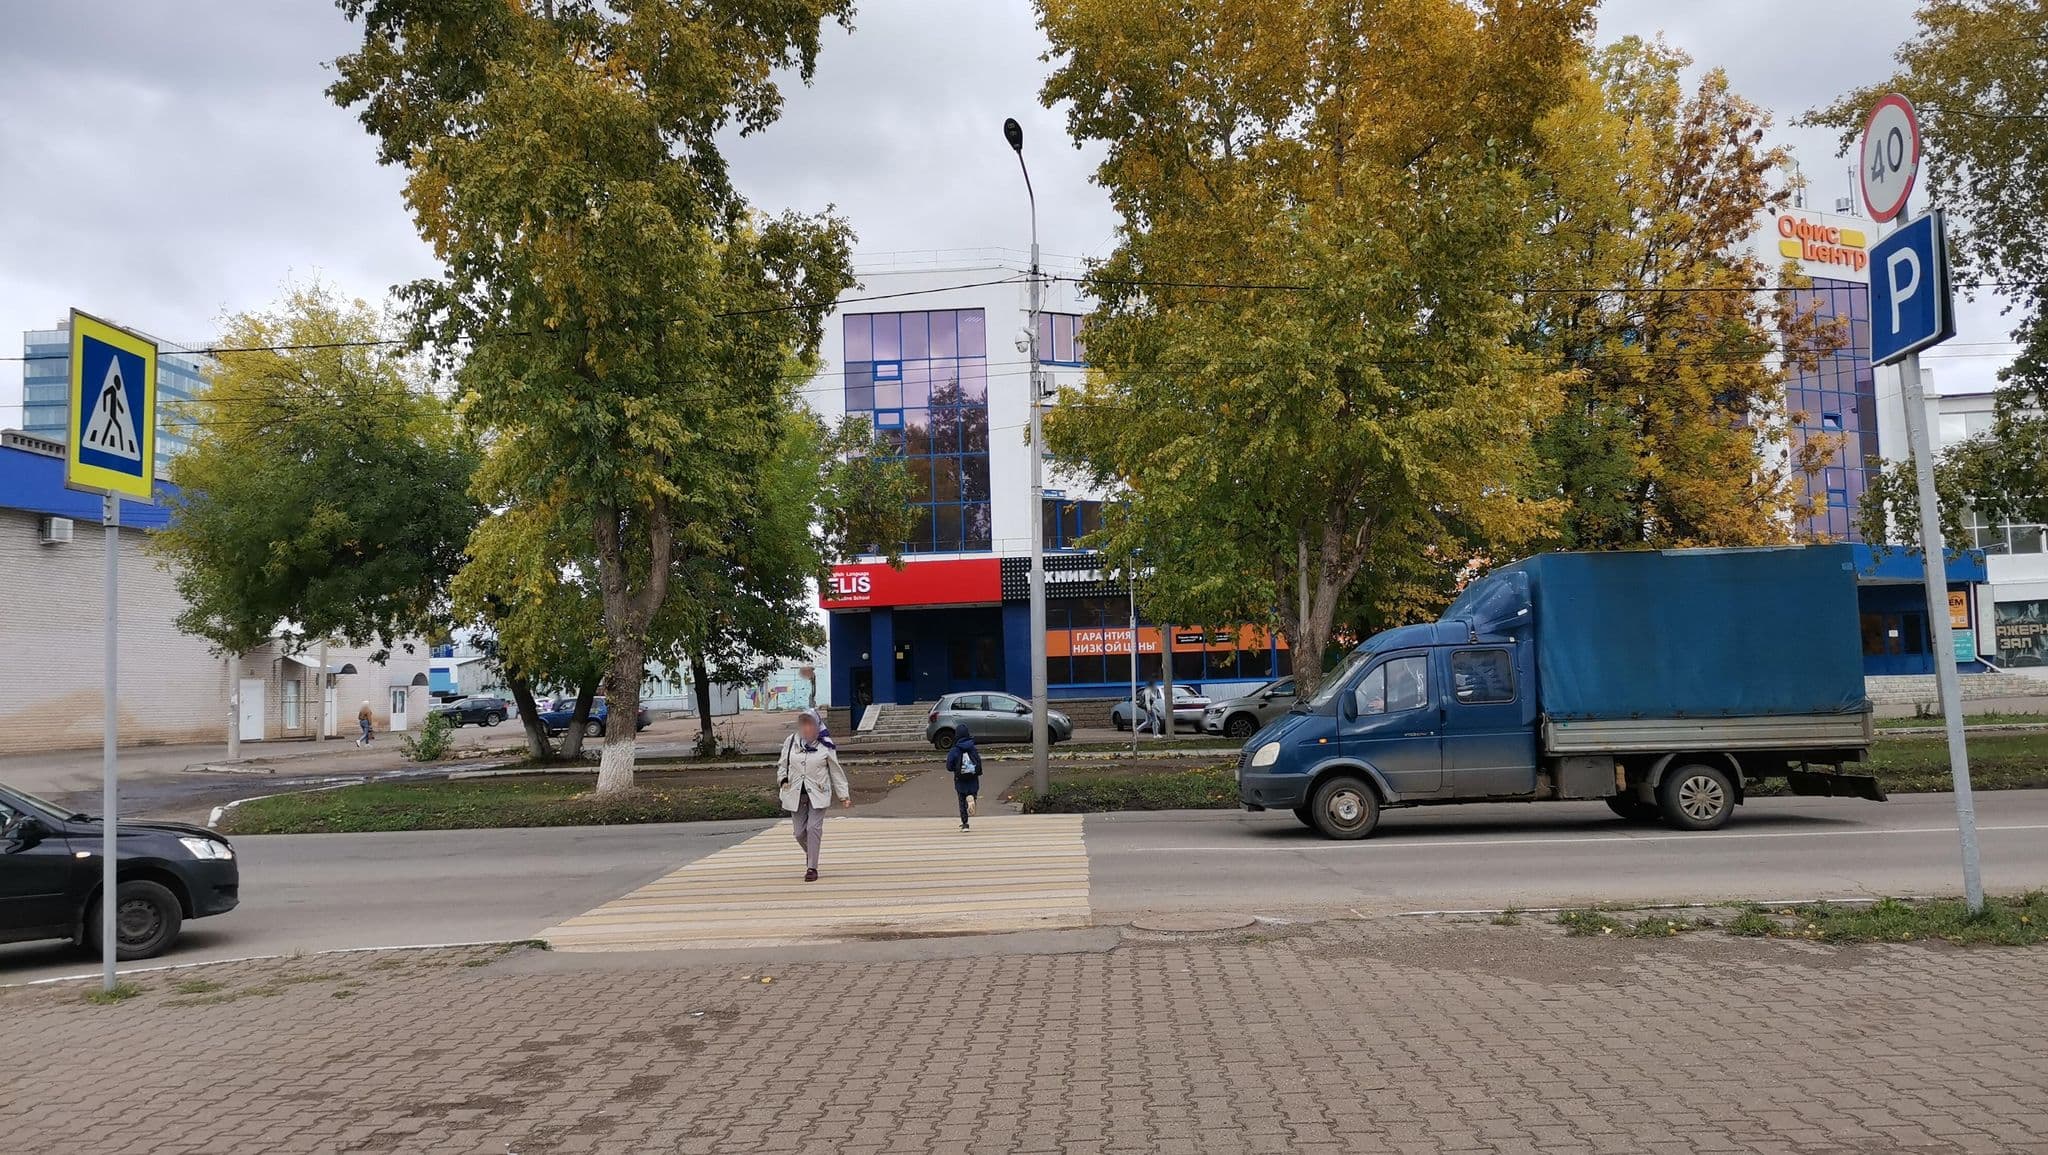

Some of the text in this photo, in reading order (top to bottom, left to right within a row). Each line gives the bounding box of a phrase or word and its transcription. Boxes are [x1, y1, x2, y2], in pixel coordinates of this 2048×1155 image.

[1871, 126, 1903, 184] 40
[1777, 215, 1839, 244] Офис
[1887, 246, 1920, 335] P
[1025, 568, 1104, 584] ТХНИКА
[828, 576, 870, 593] ELIS
[1076, 631, 1131, 641] ГАРАНТИЯ
[2000, 637, 2032, 649] ЗАЛ
[1073, 641, 1121, 653] НИЗКОЙ
